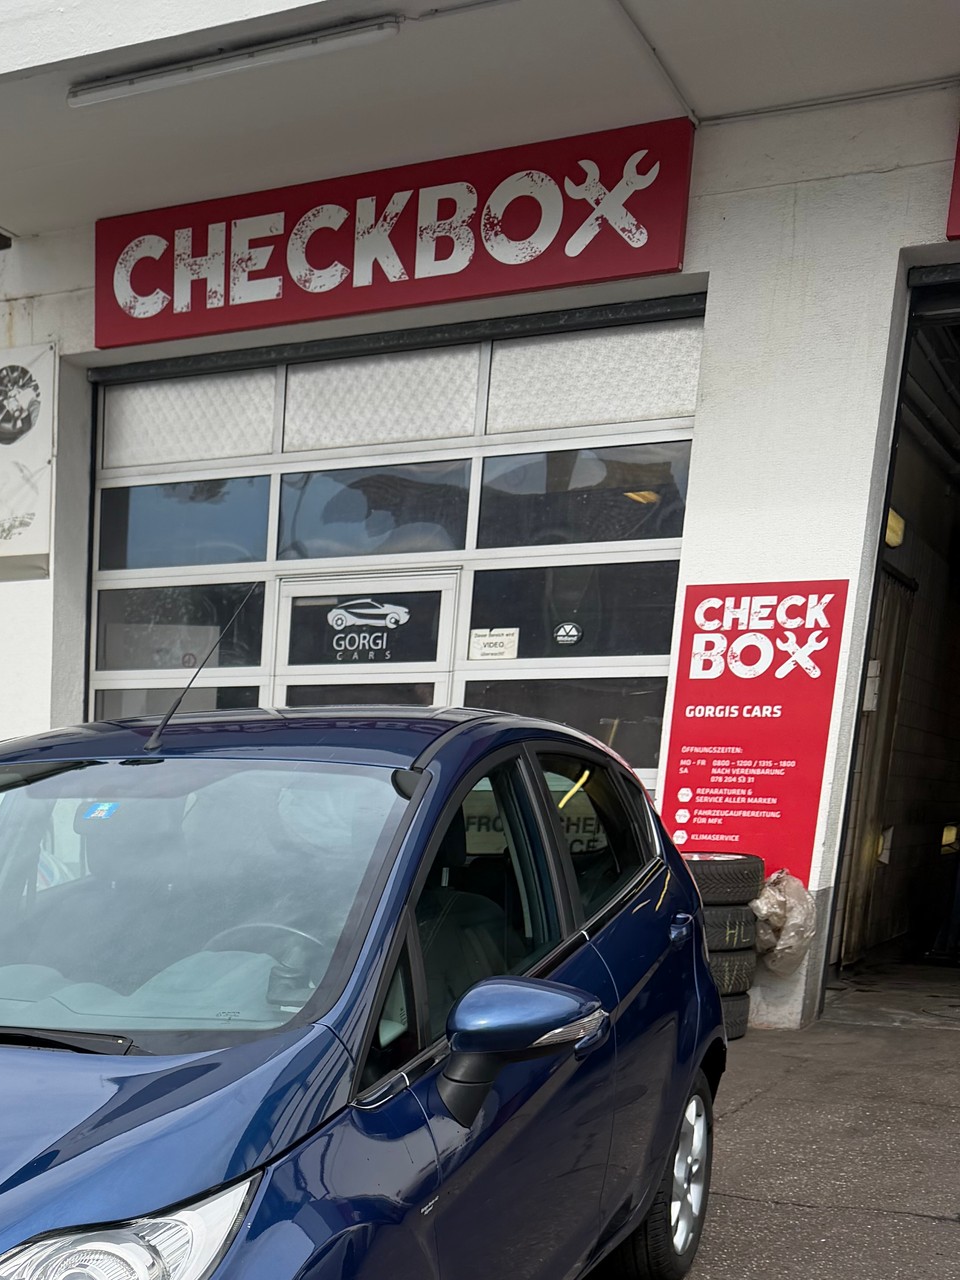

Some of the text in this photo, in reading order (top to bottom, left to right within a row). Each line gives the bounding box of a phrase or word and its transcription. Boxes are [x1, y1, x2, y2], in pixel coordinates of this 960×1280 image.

[113, 149, 660, 319] CHECKBOX
[694, 593, 836, 632] CHECK
[332, 631, 388, 651] GORGI
[483, 640, 505, 649] VIDEO
[336, 650, 392, 661] CARS
[688, 630, 830, 680] BOX
[685, 705, 783, 718] GORGIS CARS
[731, 768, 786, 776] VEREINBARUNG
[696, 788, 747, 796] REPARATUREN
[695, 796, 778, 805] SERVICE ALLER MARKEN
[693, 809, 781, 818] FAHRZEUGAUFBEREITUNG
[692, 816, 707, 825] FÜR
[690, 834, 740, 842] KLIMASERVICE
